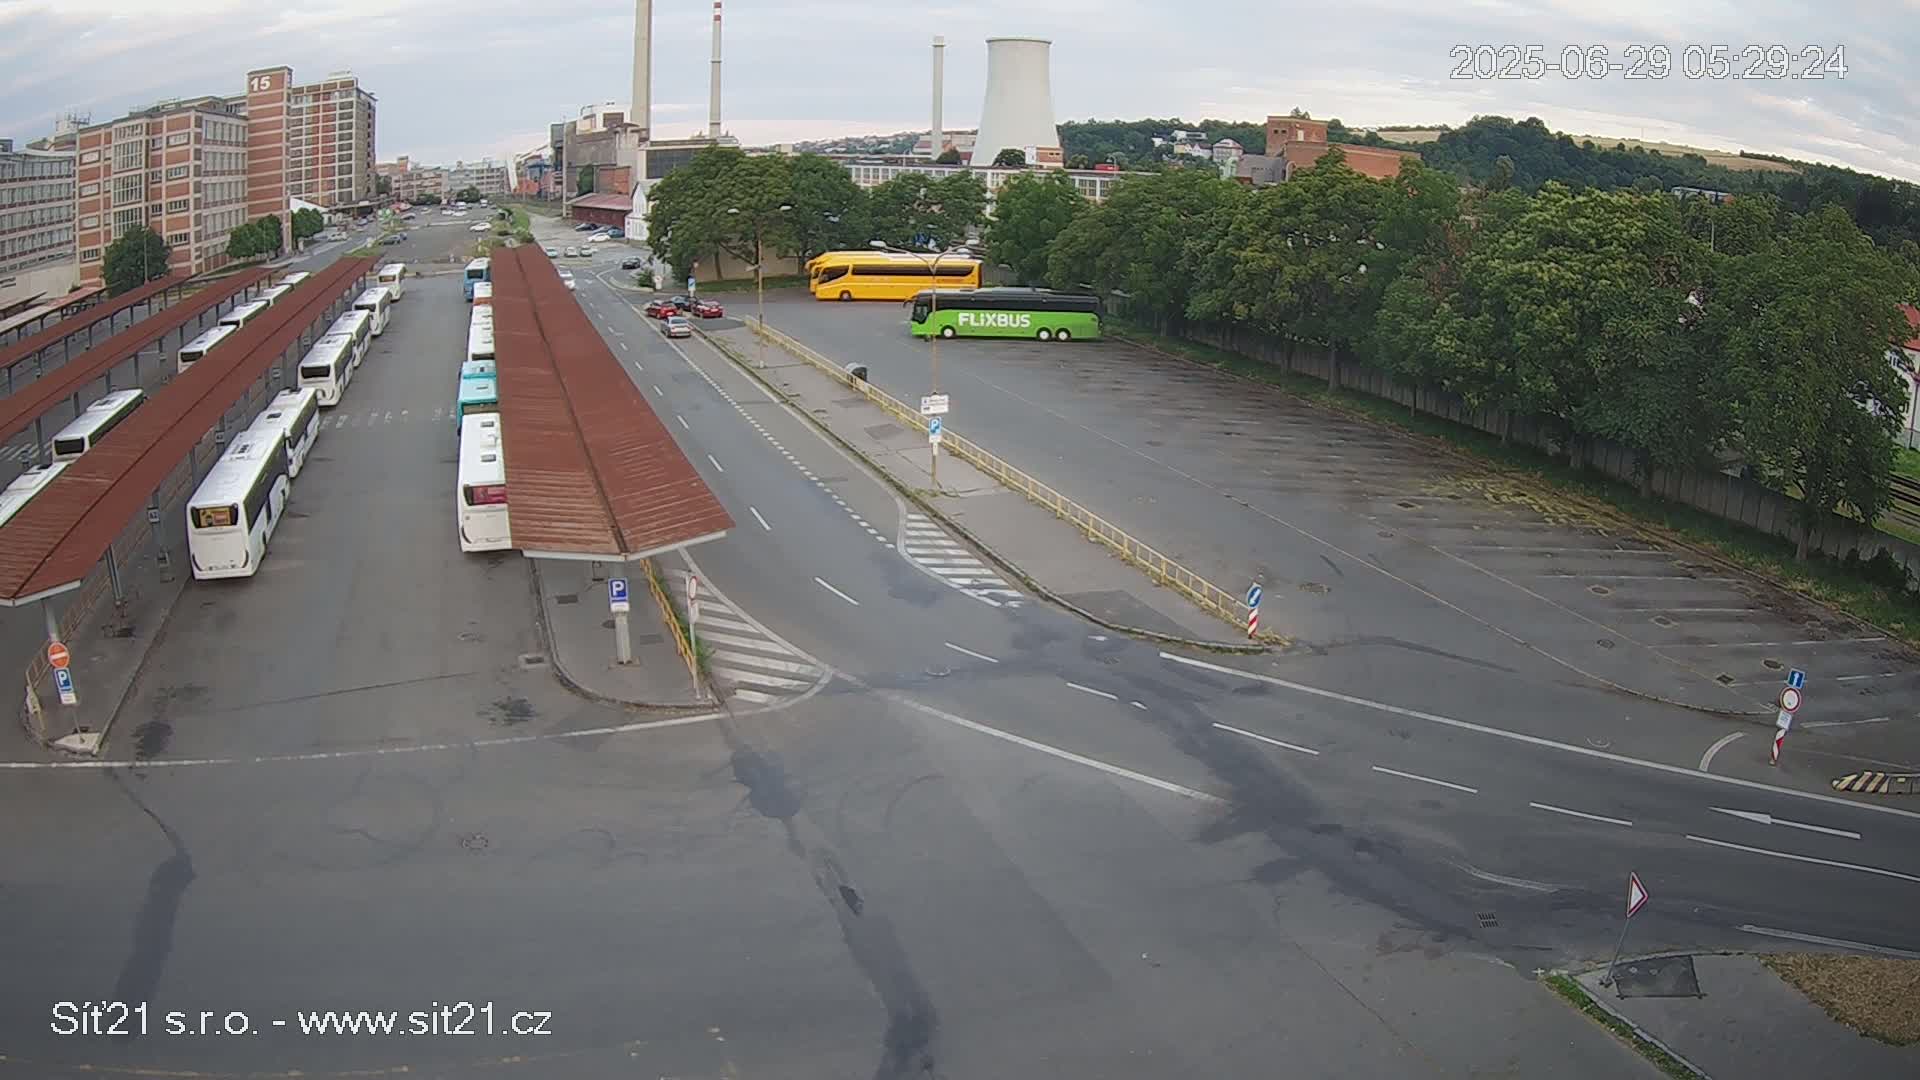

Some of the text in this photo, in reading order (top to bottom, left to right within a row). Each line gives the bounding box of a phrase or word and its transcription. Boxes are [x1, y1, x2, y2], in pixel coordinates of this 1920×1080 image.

[250, 75, 271, 92] 15
[612, 580, 625, 597] P
[58, 671, 68, 686] P
